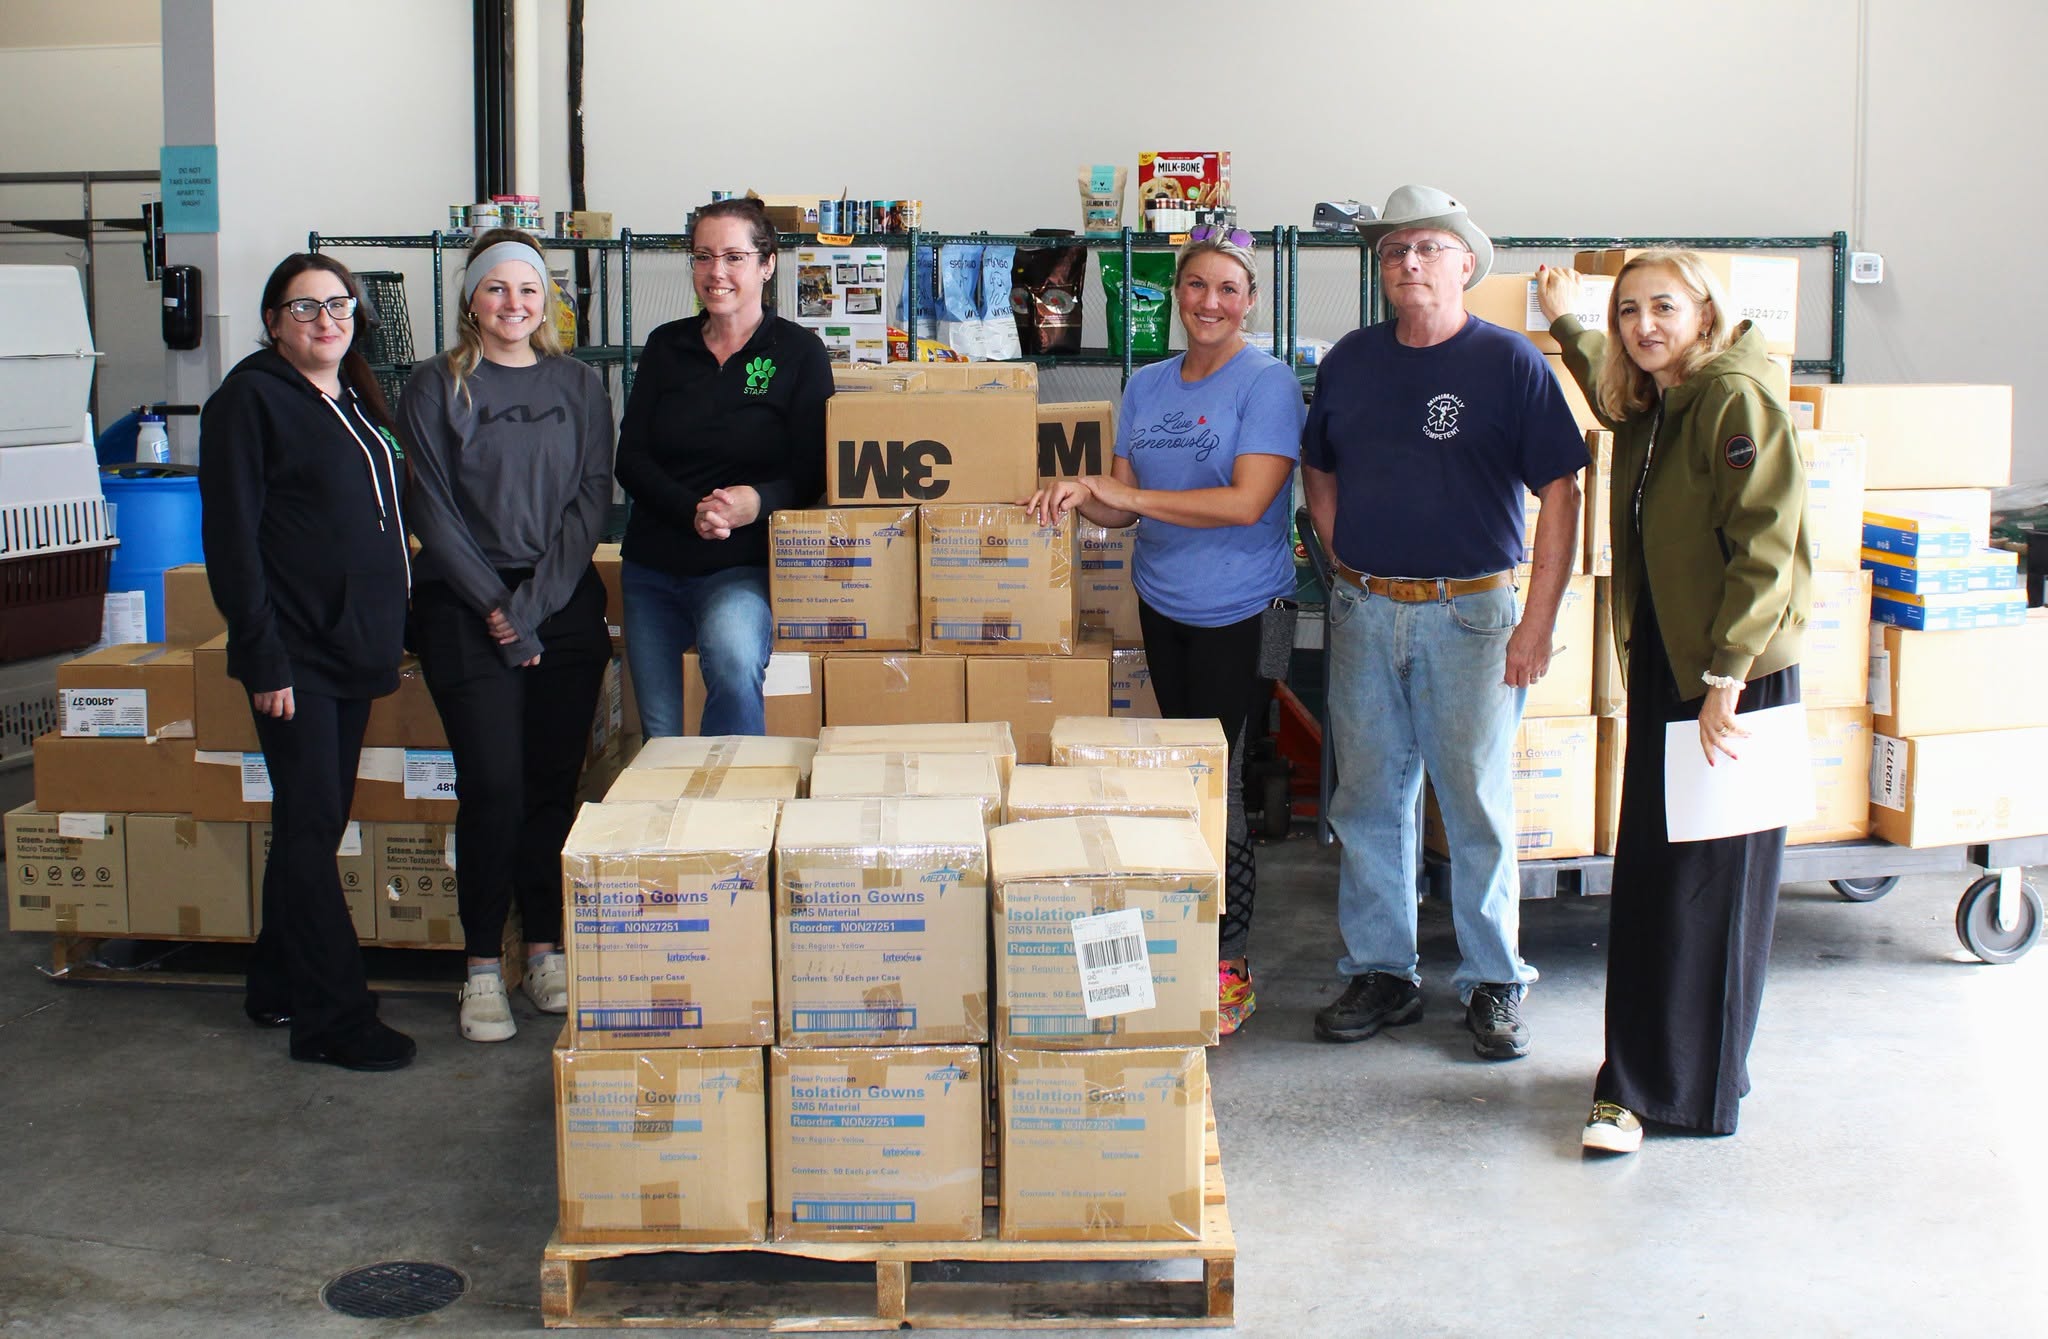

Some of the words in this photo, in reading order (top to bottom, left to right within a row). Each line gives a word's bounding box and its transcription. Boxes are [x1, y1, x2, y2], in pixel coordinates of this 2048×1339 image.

[744, 387, 768, 396] STAFF
[1426, 393, 1465, 408] MINIMALLY
[1422, 425, 1460, 440] COMPETENT
[1038, 421, 1102, 477] M
[838, 440, 952, 500] 3M
[776, 537, 825, 546] Isolation
[830, 536, 871, 546] Gowns
[931, 536, 981, 546] Isolation
[987, 536, 1029, 546] Gowns
[1084, 540, 1123, 549] Gowns
[437, 783, 456, 792] 481
[39, 845, 69, 853] Textured
[409, 856, 440, 864] Textured
[25, 866, 34, 877] L
[394, 877, 402, 888] S
[920, 873, 966, 883] MEDLINE
[597, 881, 640, 890] Protection
[710, 881, 758, 891] MEDLINE
[814, 880, 856, 888] Protection
[575, 891, 645, 905] Isolation
[650, 890, 708, 904] Gowns
[791, 891, 861, 904] Isolation
[868, 890, 925, 903] Gowns
[575, 908, 599, 918] SMS
[602, 907, 644, 918] Material
[791, 908, 815, 917] SMS
[818, 907, 860, 917] Material
[1008, 907, 1086, 921] Isolation
[624, 922, 679, 933] NON27251
[792, 923, 835, 932] Reorder:
[841, 922, 896, 931] NON27251
[1008, 925, 1032, 935] SMS
[1036, 925, 1073, 935] Materi
[618, 974, 628, 982] 50
[630, 974, 649, 983] Each
[650, 974, 664, 983] per
[666, 973, 685, 981] Case
[845, 974, 864, 982] Each
[866, 975, 879, 983] per
[925, 1072, 970, 1080] MEDLINE
[791, 1085, 861, 1098] Isolation
[868, 1085, 925, 1098] Gowns
[1012, 1089, 1082, 1102] Isolation
[1088, 1089, 1145, 1102] Gowns
[569, 1091, 638, 1104] Isolation
[645, 1090, 701, 1104] Gowns
[791, 1102, 815, 1111] SMS
[818, 1102, 860, 1111] Material
[793, 1117, 835, 1126] Reorder:
[841, 1116, 896, 1126] NON27251
